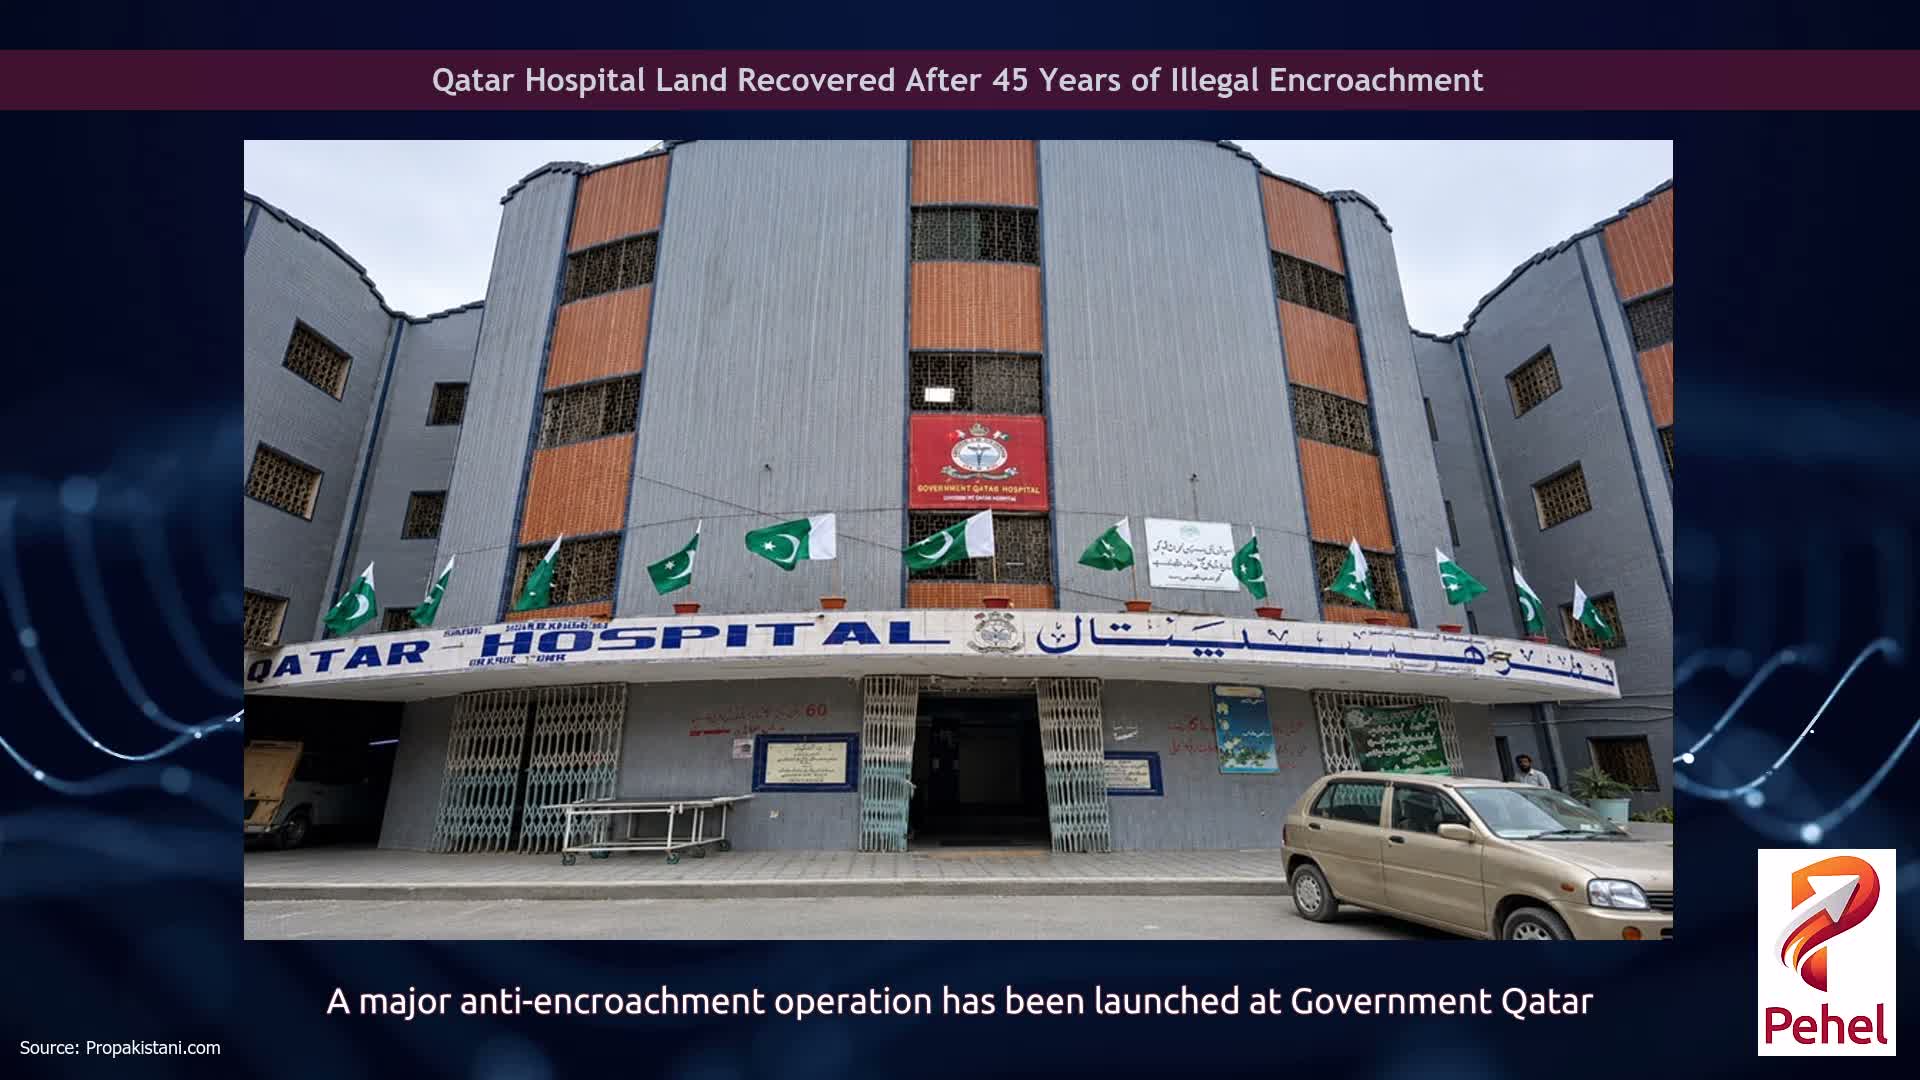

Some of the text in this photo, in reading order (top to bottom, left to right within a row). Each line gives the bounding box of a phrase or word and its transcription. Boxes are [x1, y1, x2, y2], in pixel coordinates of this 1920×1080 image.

[1002, 485, 1041, 494] HOSPITAL
[247, 640, 431, 683] QATAR
[480, 620, 951, 658] HOSPITAL
[805, 703, 828, 717] 60
